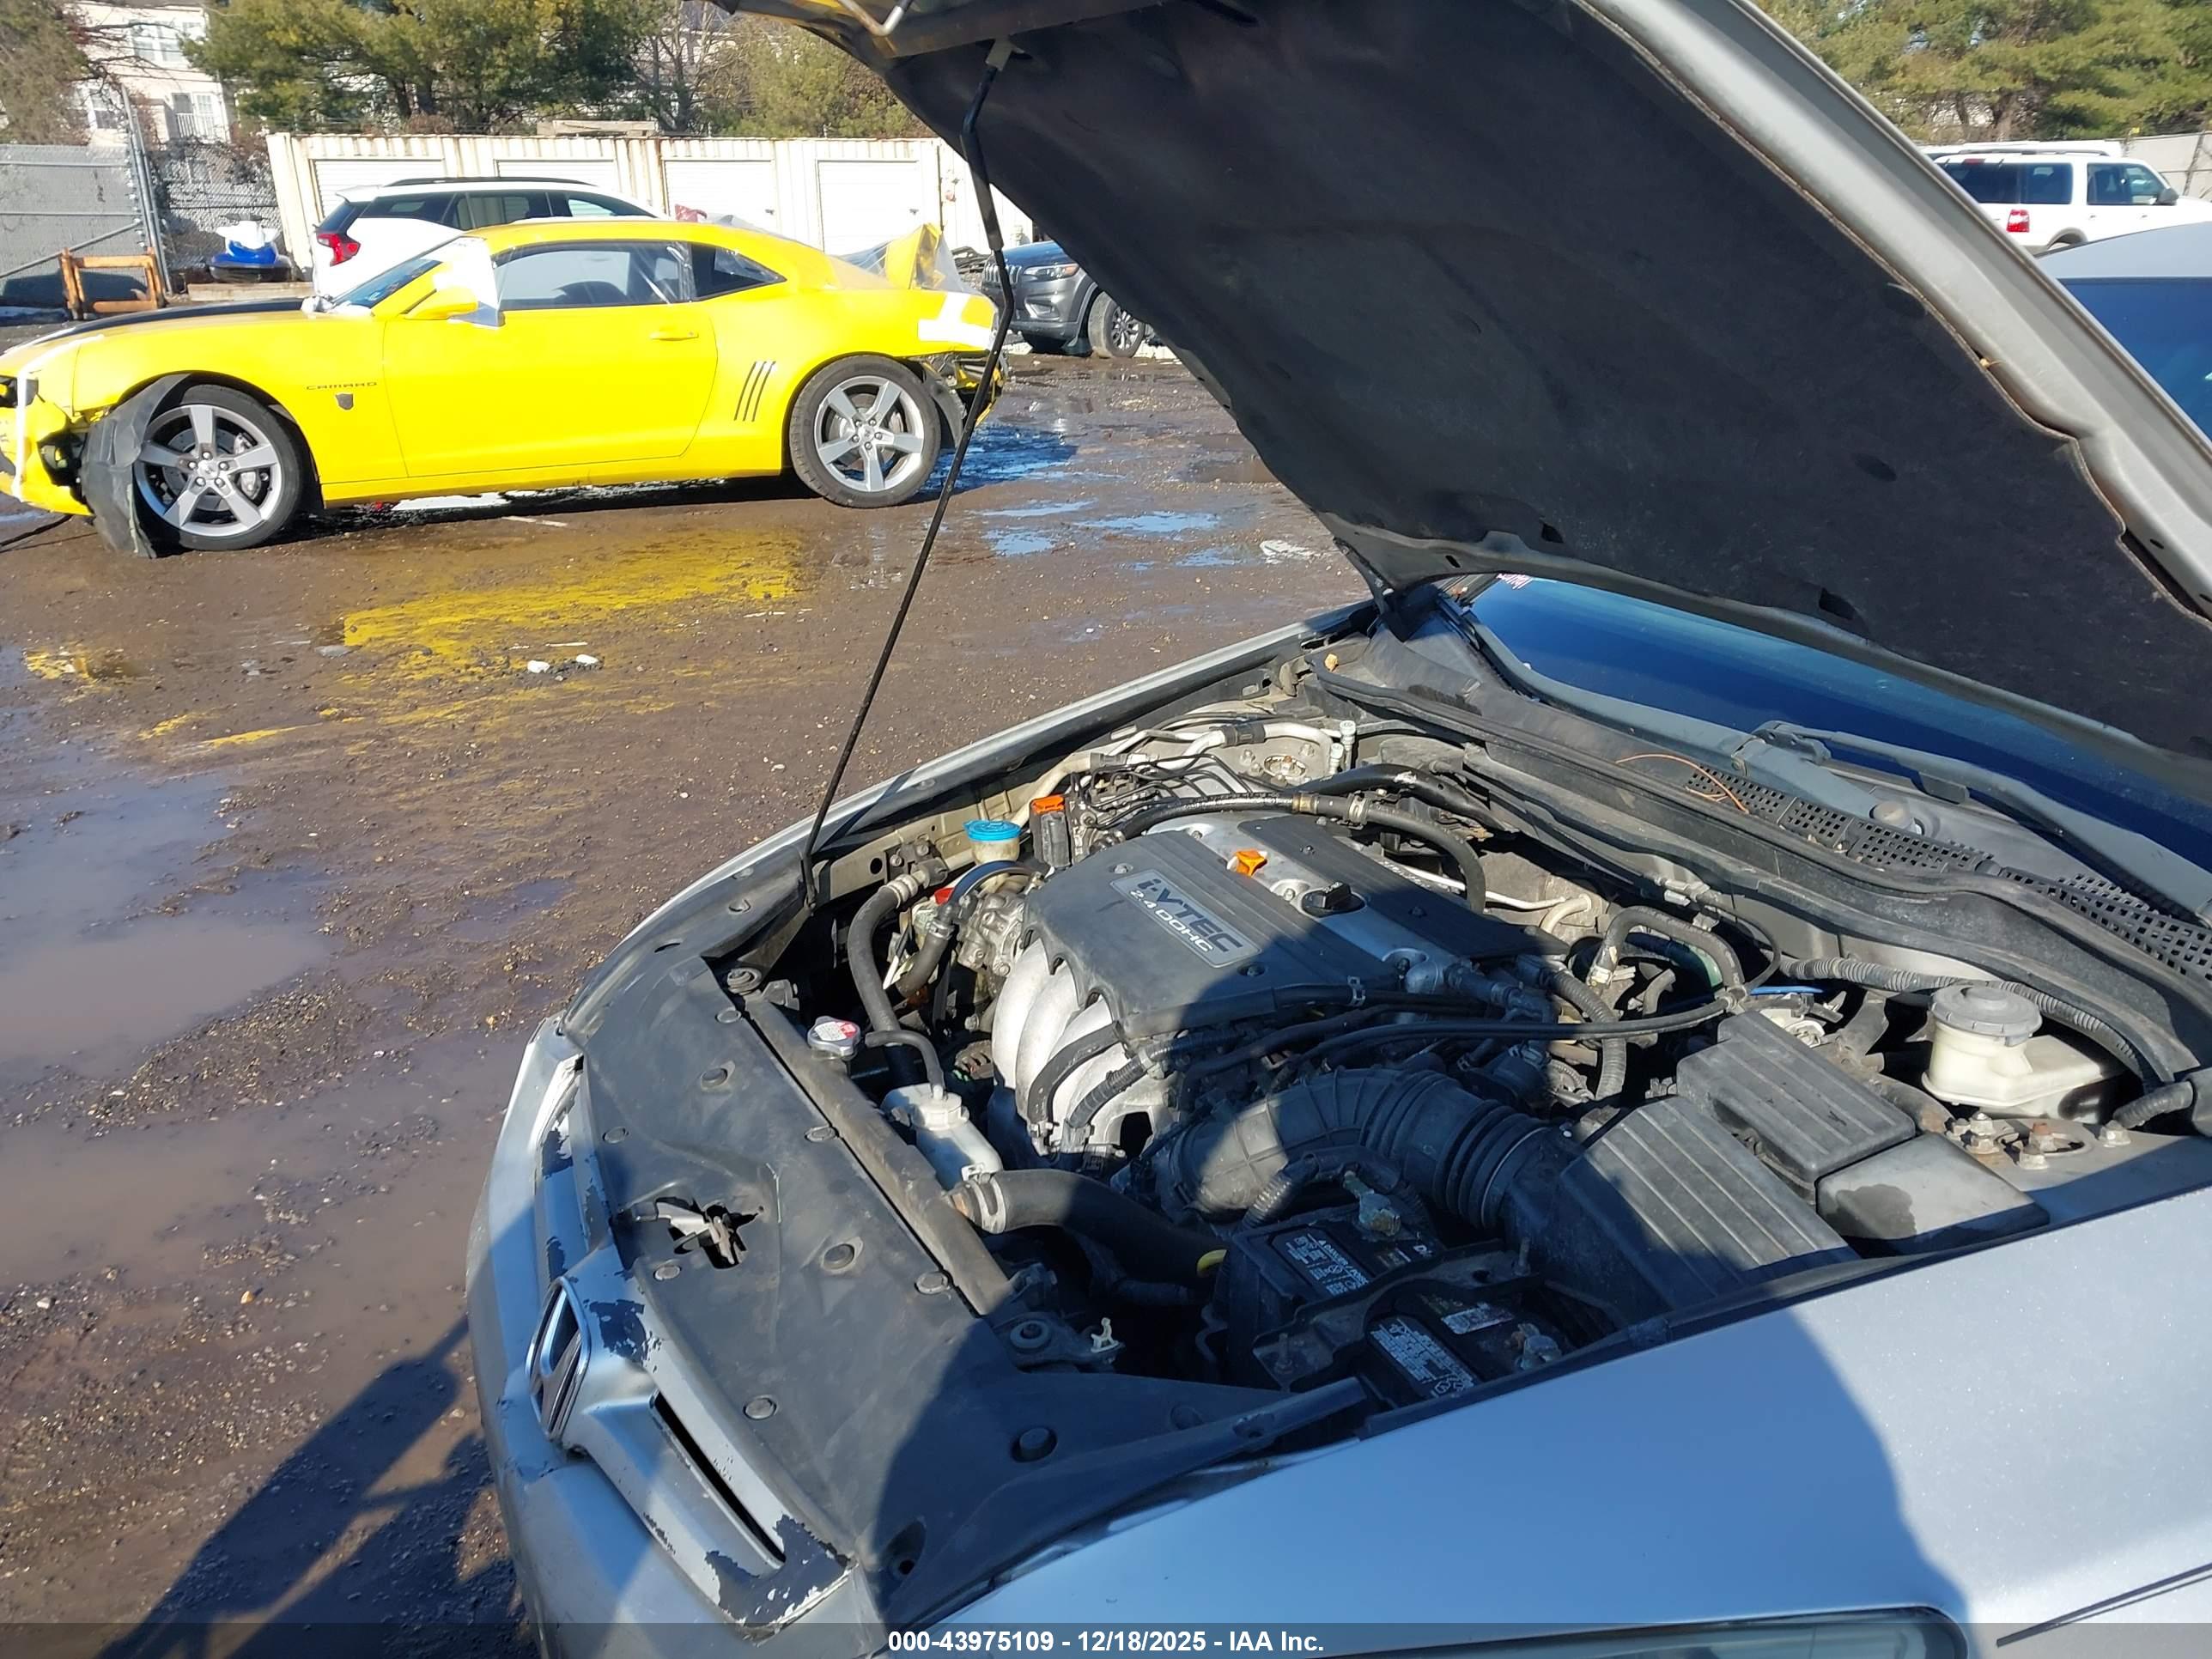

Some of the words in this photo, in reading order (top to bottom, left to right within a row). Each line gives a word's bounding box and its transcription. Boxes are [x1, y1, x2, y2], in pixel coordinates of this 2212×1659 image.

[306, 381, 378, 391] CAMARO
[1129, 890, 1158, 909] 2.4
[1155, 908, 1213, 952] DOHC
[1137, 878, 1243, 952] i-VTEC
